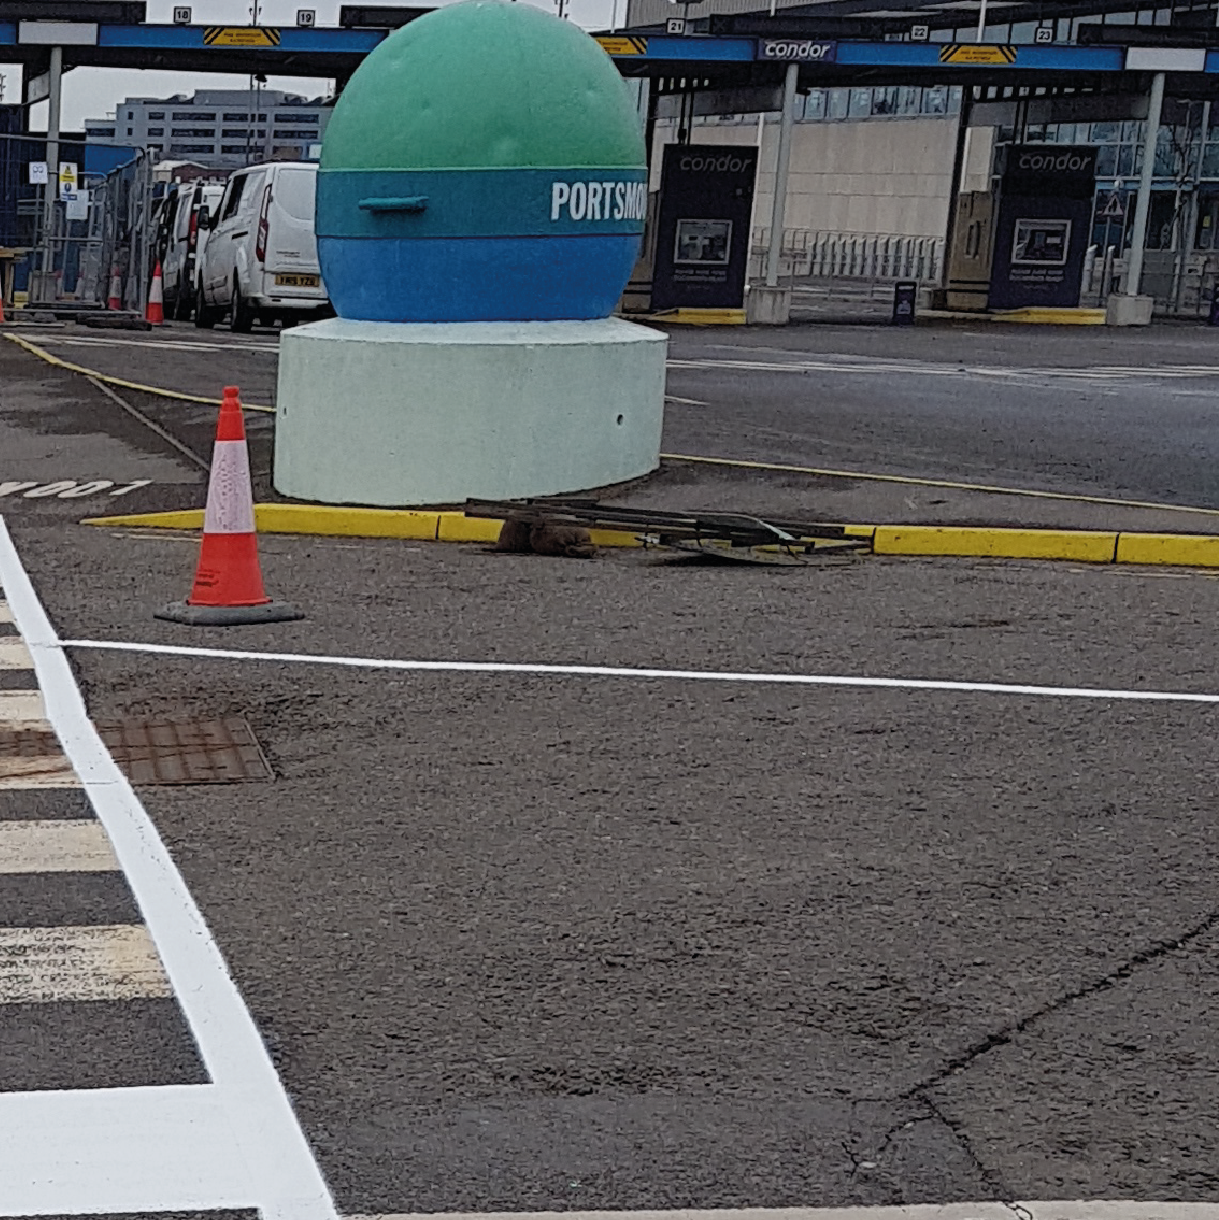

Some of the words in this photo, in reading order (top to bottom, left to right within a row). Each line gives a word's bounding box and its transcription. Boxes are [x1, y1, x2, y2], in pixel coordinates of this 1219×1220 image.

[301, 13, 312, 23] 19
[670, 22, 682, 32] 21
[914, 27, 925, 36] 22
[1038, 30, 1051, 41] 23
[765, 40, 831, 58] condor
[680, 154, 753, 172] condor
[1018, 153, 1092, 171] condor
